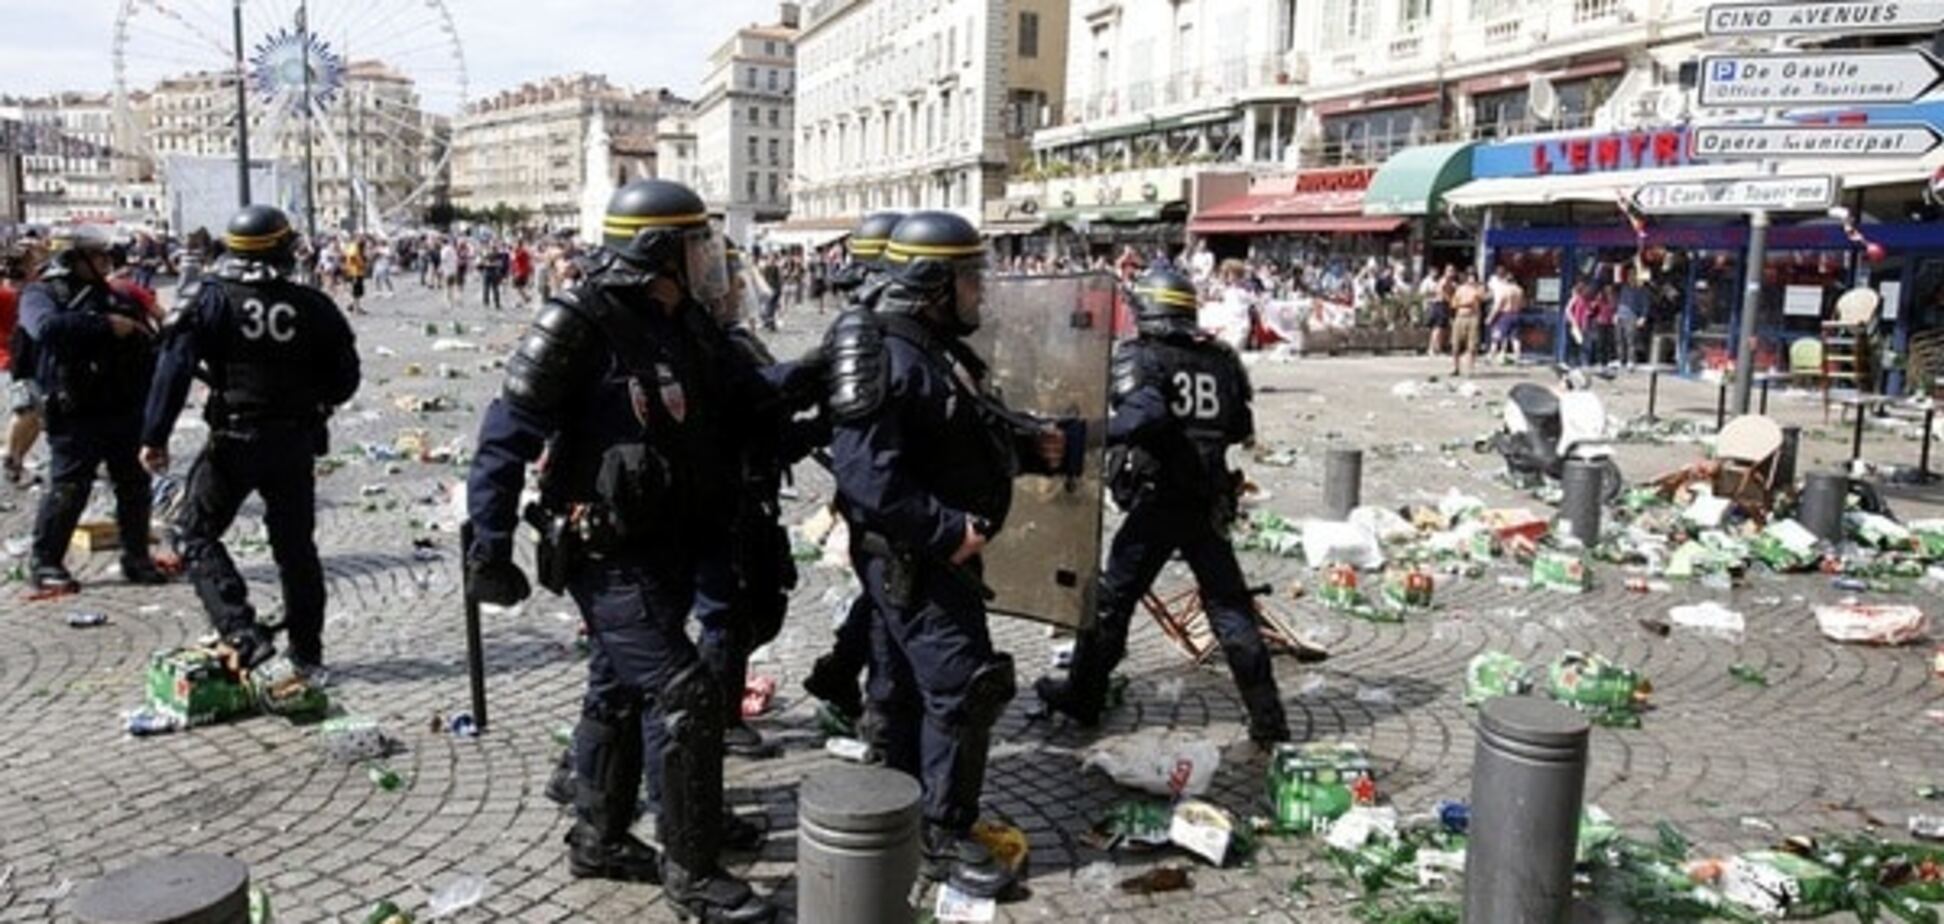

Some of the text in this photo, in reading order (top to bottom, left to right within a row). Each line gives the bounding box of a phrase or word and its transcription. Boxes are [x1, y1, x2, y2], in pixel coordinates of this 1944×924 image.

[1716, 3, 1899, 28] CINQ AVENUES
[1742, 61, 1858, 79] De Gaulle
[1780, 83, 1800, 95] de
[1533, 131, 1694, 176] L'ENTR
[1783, 132, 1904, 153] Municipal
[242, 298, 296, 342] 3C
[1171, 371, 1220, 419] 3B
